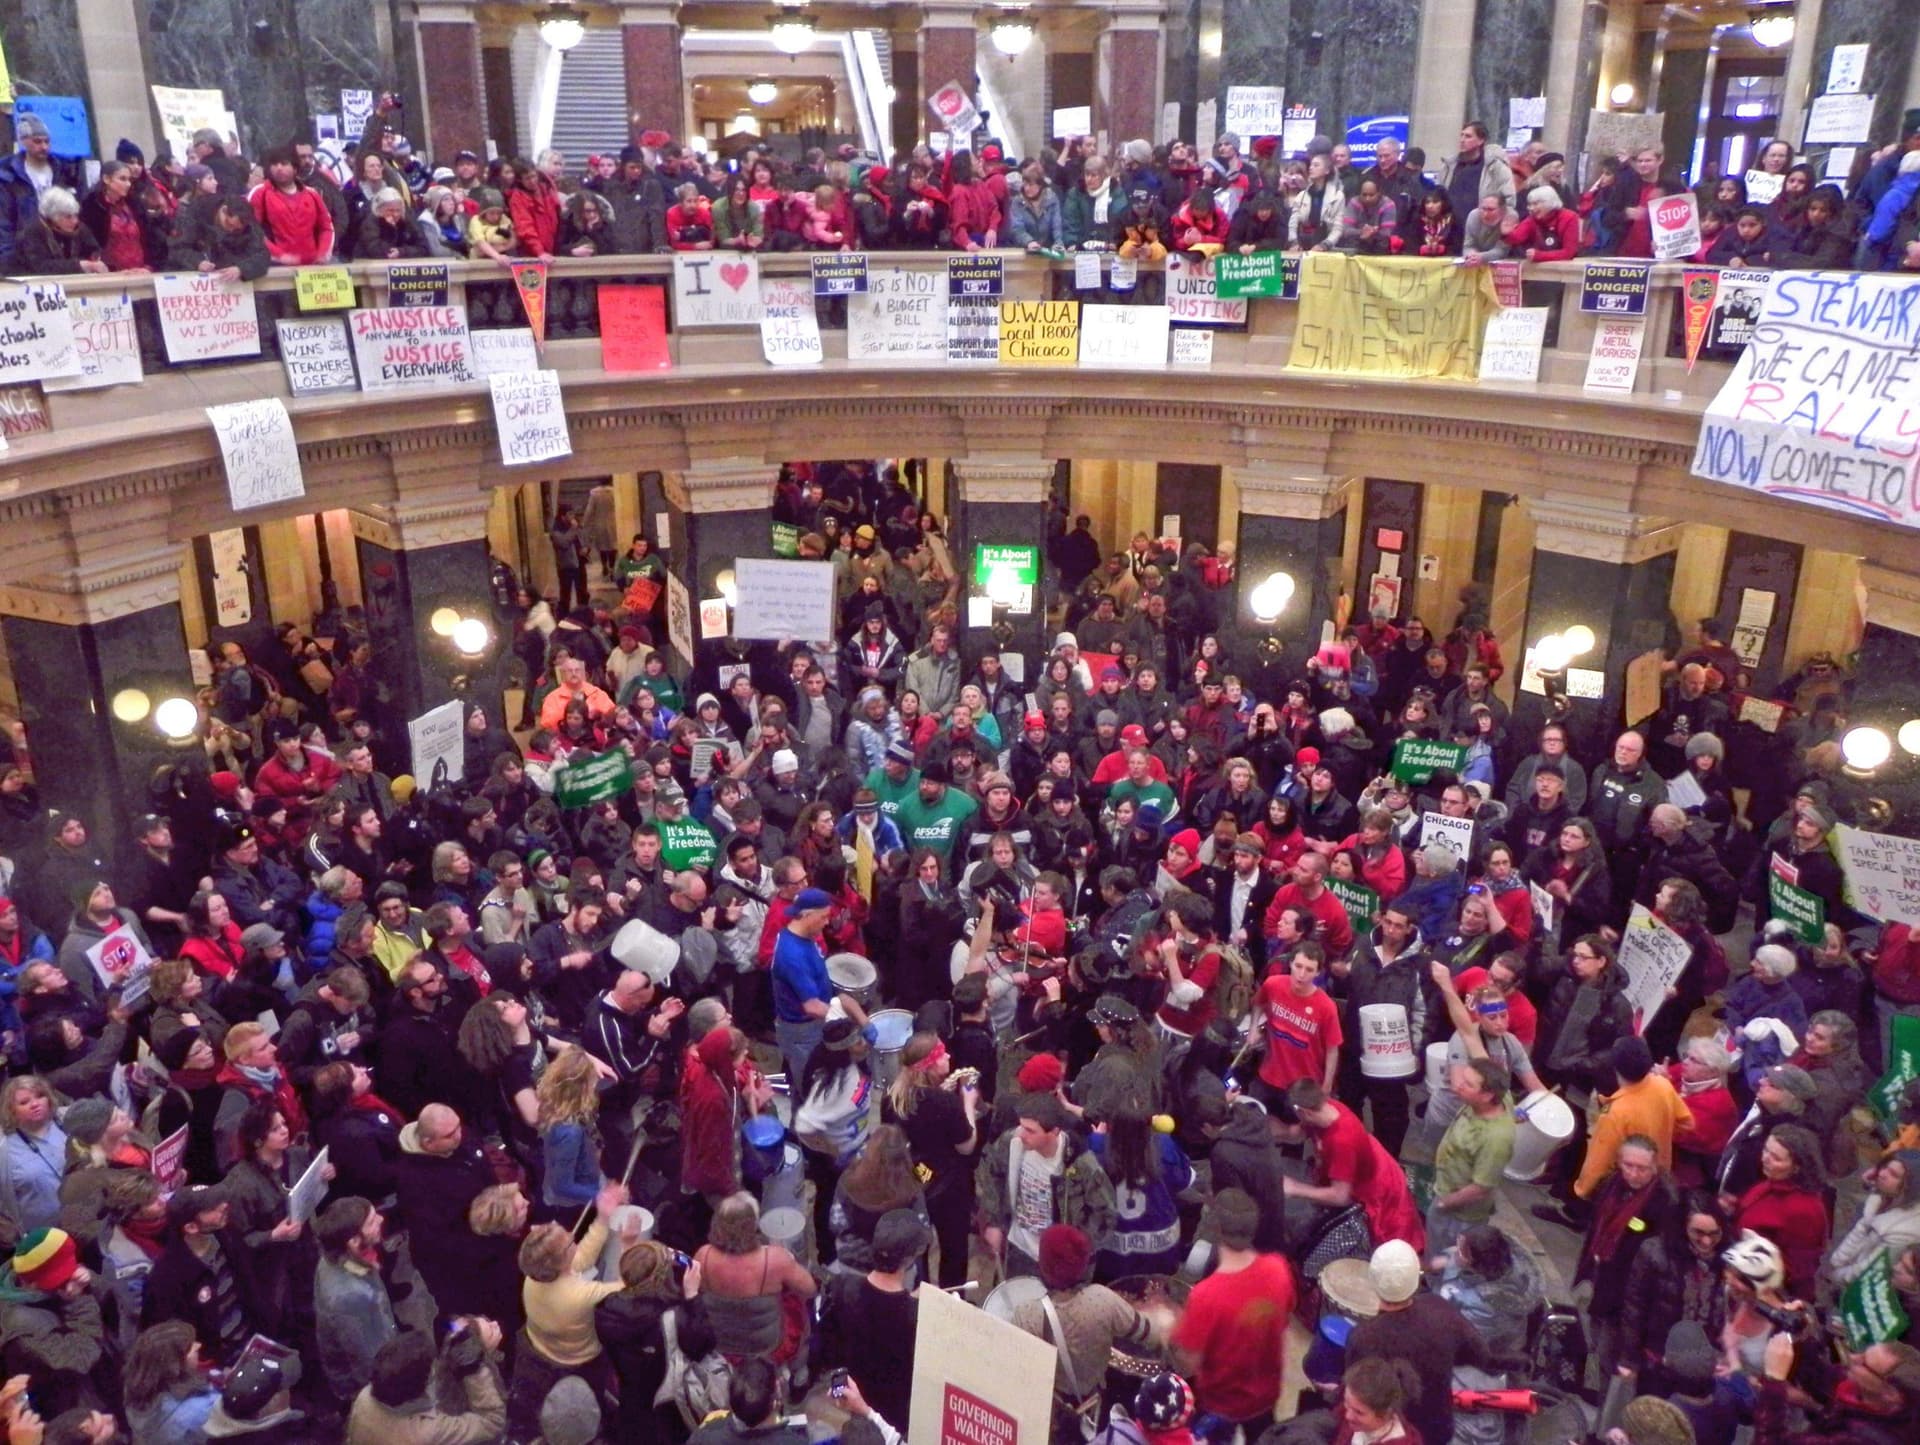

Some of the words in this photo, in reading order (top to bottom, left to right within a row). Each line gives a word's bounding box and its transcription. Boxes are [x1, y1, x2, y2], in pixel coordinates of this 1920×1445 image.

[1286, 108, 1316, 119] SEIU
[1658, 205, 1689, 224] STOP
[814, 256, 838, 264] ONE
[842, 255, 864, 264] DAY
[951, 258, 974, 266] ONE
[978, 257, 1000, 265] DAY
[1222, 257, 1239, 269] It's
[1241, 255, 1275, 268] About
[1282, 260, 1297, 268] AY
[309, 272, 338, 280] STRONG
[391, 267, 417, 276] ONE
[421, 266, 445, 275] DAY
[814, 267, 865, 277] LONGER!
[951, 270, 1001, 279] LONGER!
[1188, 261, 1216, 277] NO
[1222, 267, 1275, 281] Freedom!
[1587, 268, 1616, 277] ONE
[1620, 268, 1646, 278] DAY
[684, 261, 711, 296] I
[868, 279, 885, 295] HIS
[891, 278, 902, 292] IS
[906, 273, 936, 293] NOT
[1721, 272, 1770, 284] CHICAGO
[190, 280, 219, 292] WE
[391, 281, 447, 291] LONGER!
[775, 281, 794, 291] THE
[1177, 280, 1217, 295] UNIO
[1585, 281, 1645, 293] LONGER!
[161, 294, 242, 308] REPRESENT
[762, 291, 812, 306] UNIONS
[949, 296, 999, 308] PAINTERS
[0, 301, 26, 320] cago
[766, 307, 799, 318] MAKE
[873, 301, 881, 315] A
[887, 299, 931, 313] BUDGET
[1001, 303, 1077, 325] U.W.U.A.
[1167, 296, 1242, 320] BUSTING
[1768, 275, 1920, 344] STEWAR
[353, 308, 460, 334] INJUSTICE
[894, 314, 921, 326] BILL
[949, 317, 972, 327] ALLIED
[973, 317, 998, 327] TRADES
[1363, 303, 1453, 336] FROM
[1719, 318, 1746, 331] JOBS
[0, 323, 46, 345] chools
[180, 325, 207, 338] WI
[213, 321, 257, 335] VOTERS
[281, 325, 327, 342] NOBODY
[365, 330, 416, 342] ANYWHERE
[439, 326, 466, 337] THREAT
[774, 320, 804, 336] WI
[1000, 325, 1035, 341] Local
[1604, 325, 1635, 336] SHEET
[73, 320, 134, 353] SCOTT
[407, 337, 419, 345] TO
[949, 339, 982, 350] SUPPORT
[983, 338, 999, 349] OUR
[1602, 336, 1632, 347] METAL
[1717, 331, 1753, 344] JUSTIC
[287, 344, 324, 355] WINS
[384, 342, 463, 362] JUSTICE
[766, 337, 820, 352] STRONG
[1009, 340, 1071, 358] Chicago
[1293, 324, 1354, 372] SAN
[0, 354, 30, 367] hers
[949, 351, 969, 359] PUBLIC
[970, 350, 998, 359] WORKERS
[1595, 347, 1638, 360] WORKERS
[289, 359, 351, 374] TEACHERS
[382, 358, 467, 380] EVERYWHERE
[1594, 367, 1612, 375] LOCAL
[1749, 342, 1803, 384] WE
[1800, 345, 1920, 402] CAME
[294, 375, 331, 389] LOSE
[495, 373, 551, 389] SMALL
[0, 388, 38, 415] NCE
[506, 402, 553, 419] OWNER
[0, 413, 48, 437] ONSIN
[1736, 382, 1920, 459] RALLY
[514, 427, 560, 442] WORKER
[228, 447, 258, 468] THIS
[265, 440, 287, 457] BILL
[509, 437, 570, 459] RIGHTS
[1697, 425, 1768, 487] NOW
[1770, 445, 1855, 495] COME
[1860, 458, 1906, 505] TO
[983, 548, 999, 559] It's
[1001, 548, 1032, 560] About
[1404, 743, 1421, 755] It's
[1423, 744, 1459, 758] About
[1401, 753, 1457, 769] Freedom!
[880, 801, 899, 810] AFS
[1425, 815, 1470, 831] CHICAGO
[667, 825, 685, 837] It's
[686, 825, 710, 836] Abou
[914, 827, 951, 837] AFSCME
[1871, 834, 1920, 853] WALKE
[1848, 846, 1880, 859] TAKE
[1885, 851, 1897, 862] IT
[1853, 859, 1898, 873] SPECIAL
[1332, 882, 1370, 904] About
[1782, 885, 1817, 912] About
[1886, 889, 1920, 903] TEAC
[1342, 899, 1369, 918] dom!
[1772, 887, 1817, 925] reedom!
[949, 1393, 1013, 1441] GOVERNOR
[954, 1414, 1004, 1445] WALKER
